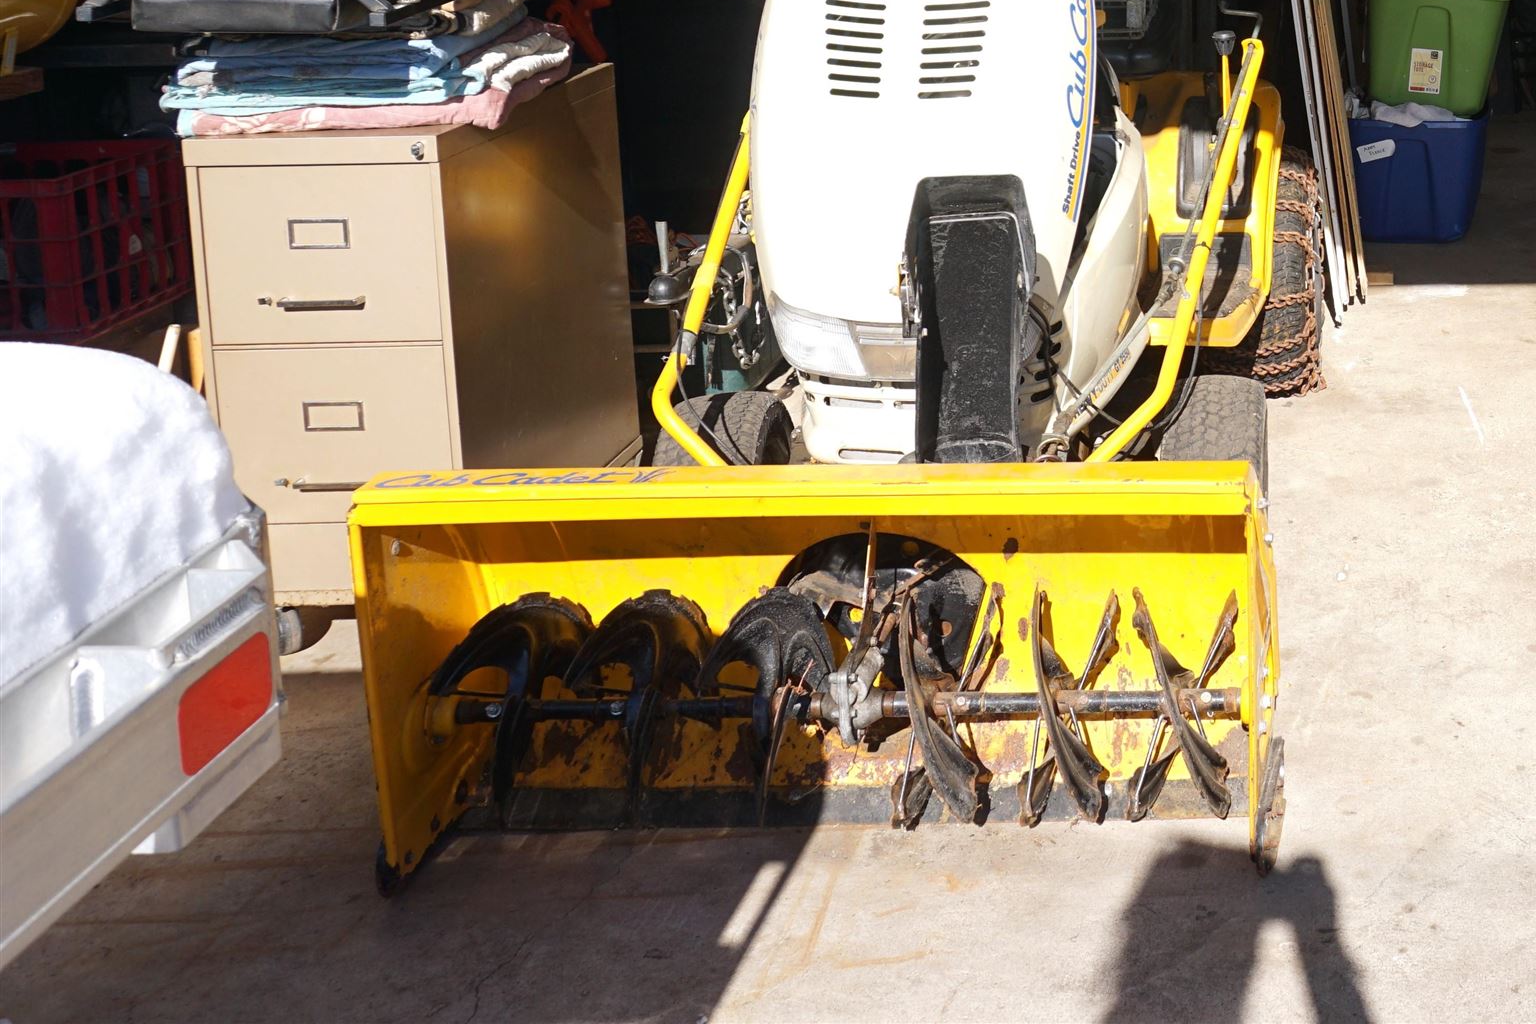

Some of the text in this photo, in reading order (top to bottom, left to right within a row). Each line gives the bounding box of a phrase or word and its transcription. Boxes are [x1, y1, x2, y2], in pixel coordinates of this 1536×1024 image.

[1067, 49, 1087, 129] Cub
[1062, 130, 1082, 214] Shaft Drive
[375, 471, 626, 489] Cub Cadet
